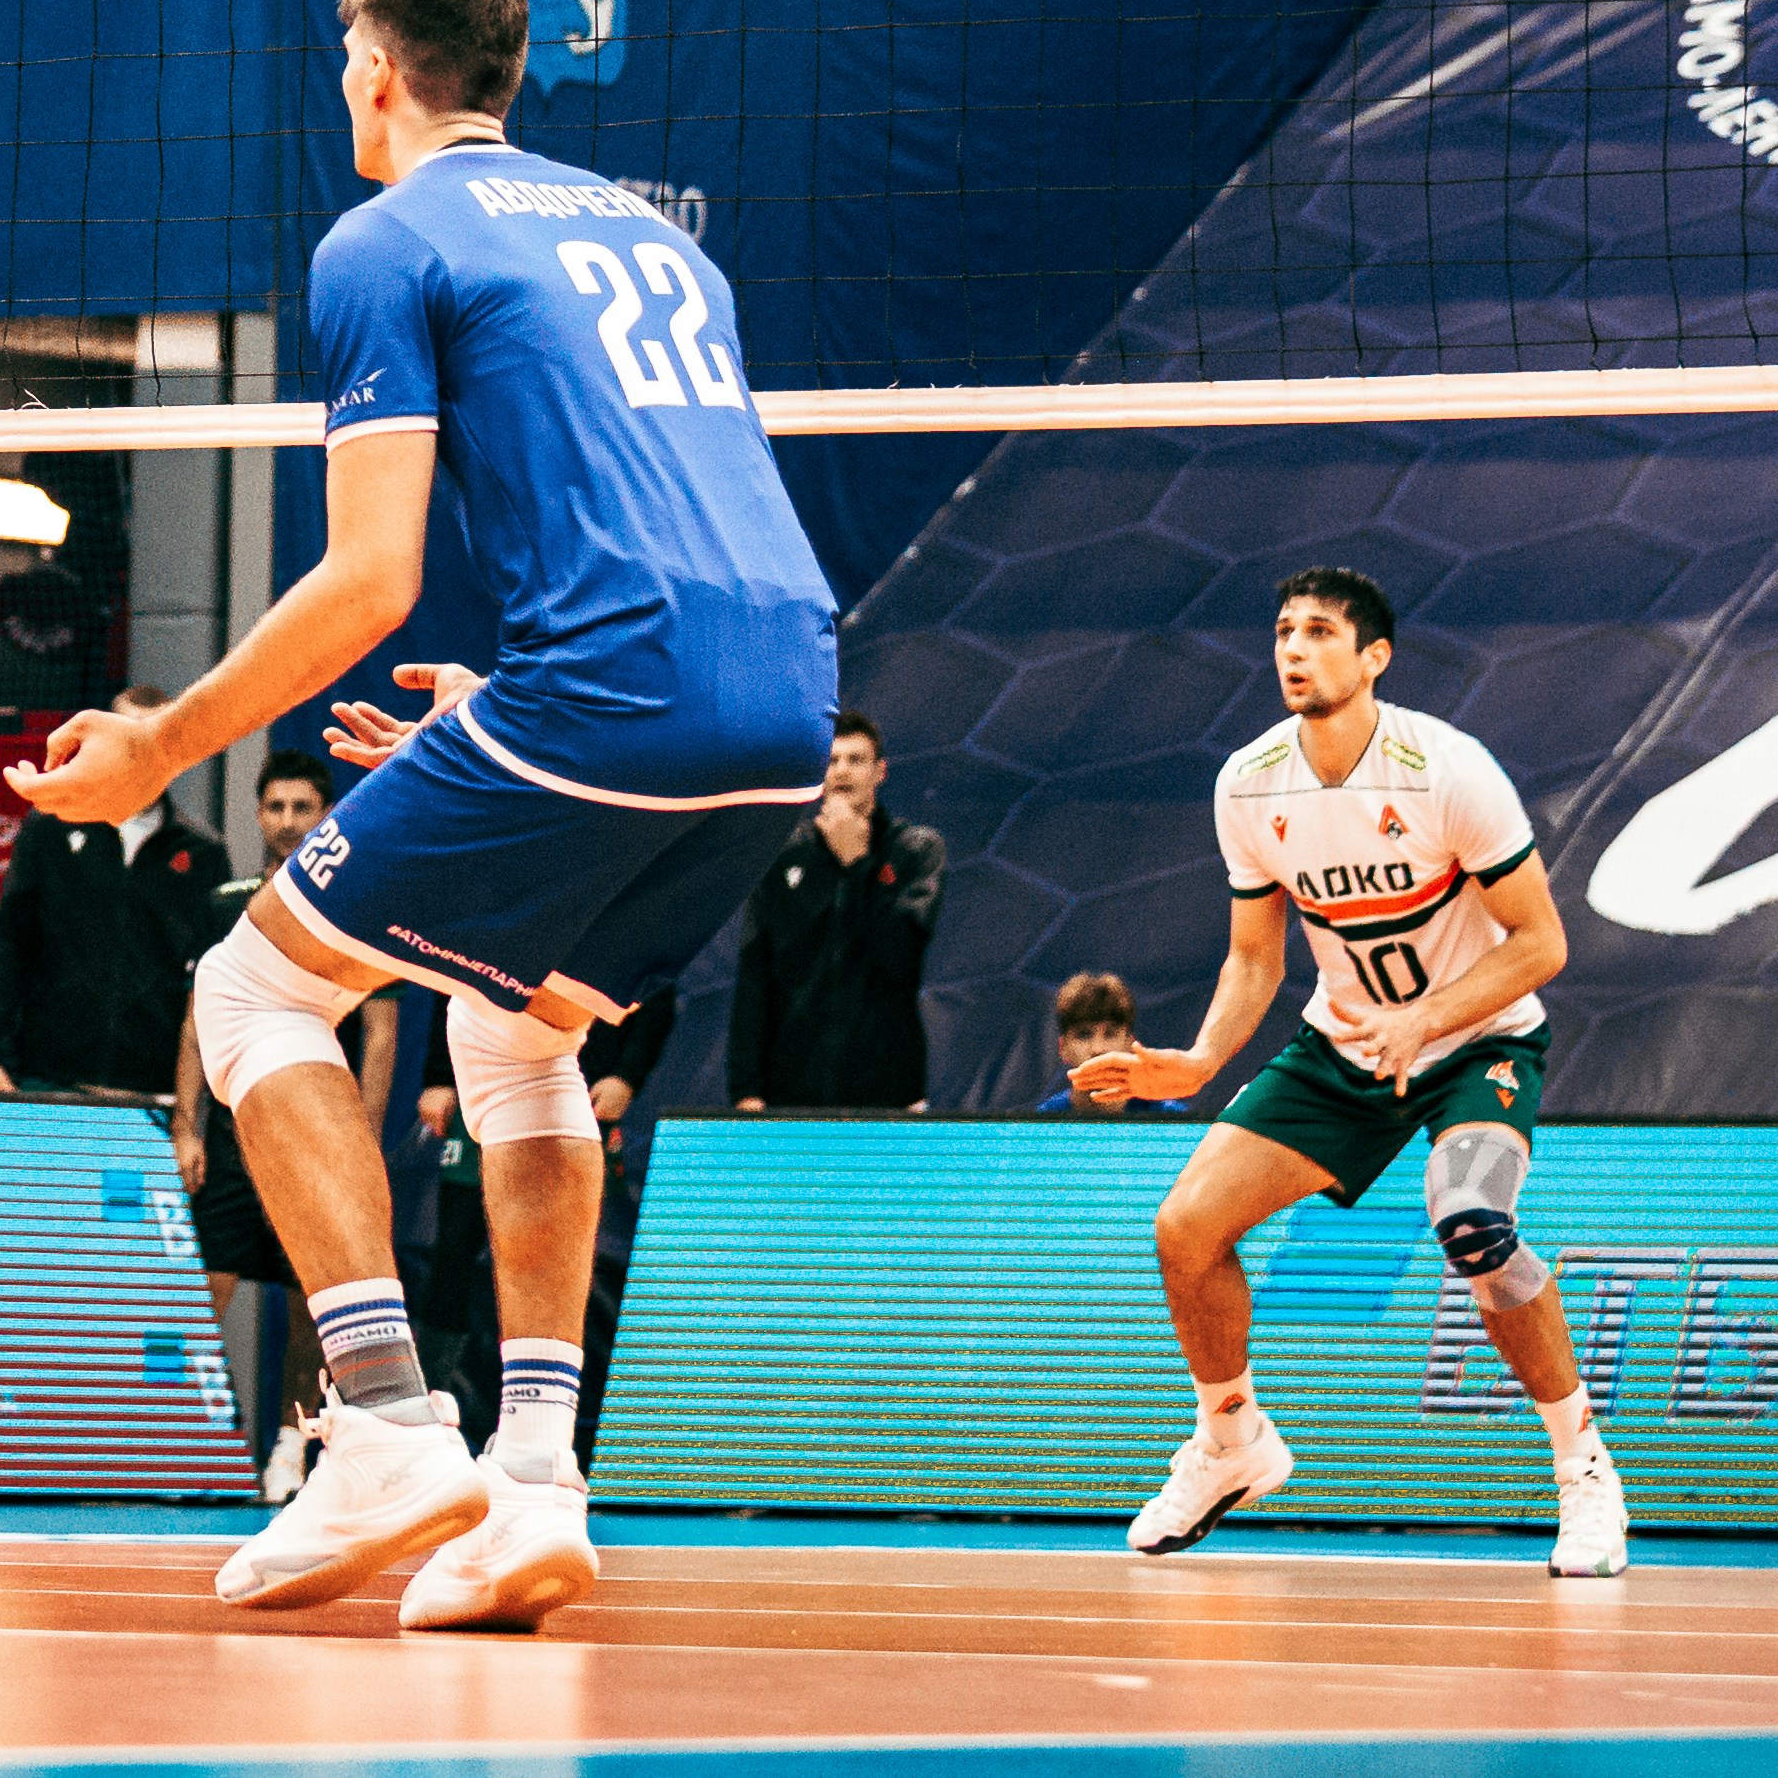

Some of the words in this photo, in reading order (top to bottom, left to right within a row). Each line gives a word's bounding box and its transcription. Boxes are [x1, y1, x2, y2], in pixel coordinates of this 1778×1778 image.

[555, 240, 747, 411] 22
[297, 818, 351, 891] 22
[1297, 862, 1415, 899] ЛОКО
[1344, 941, 1429, 1005] 10
